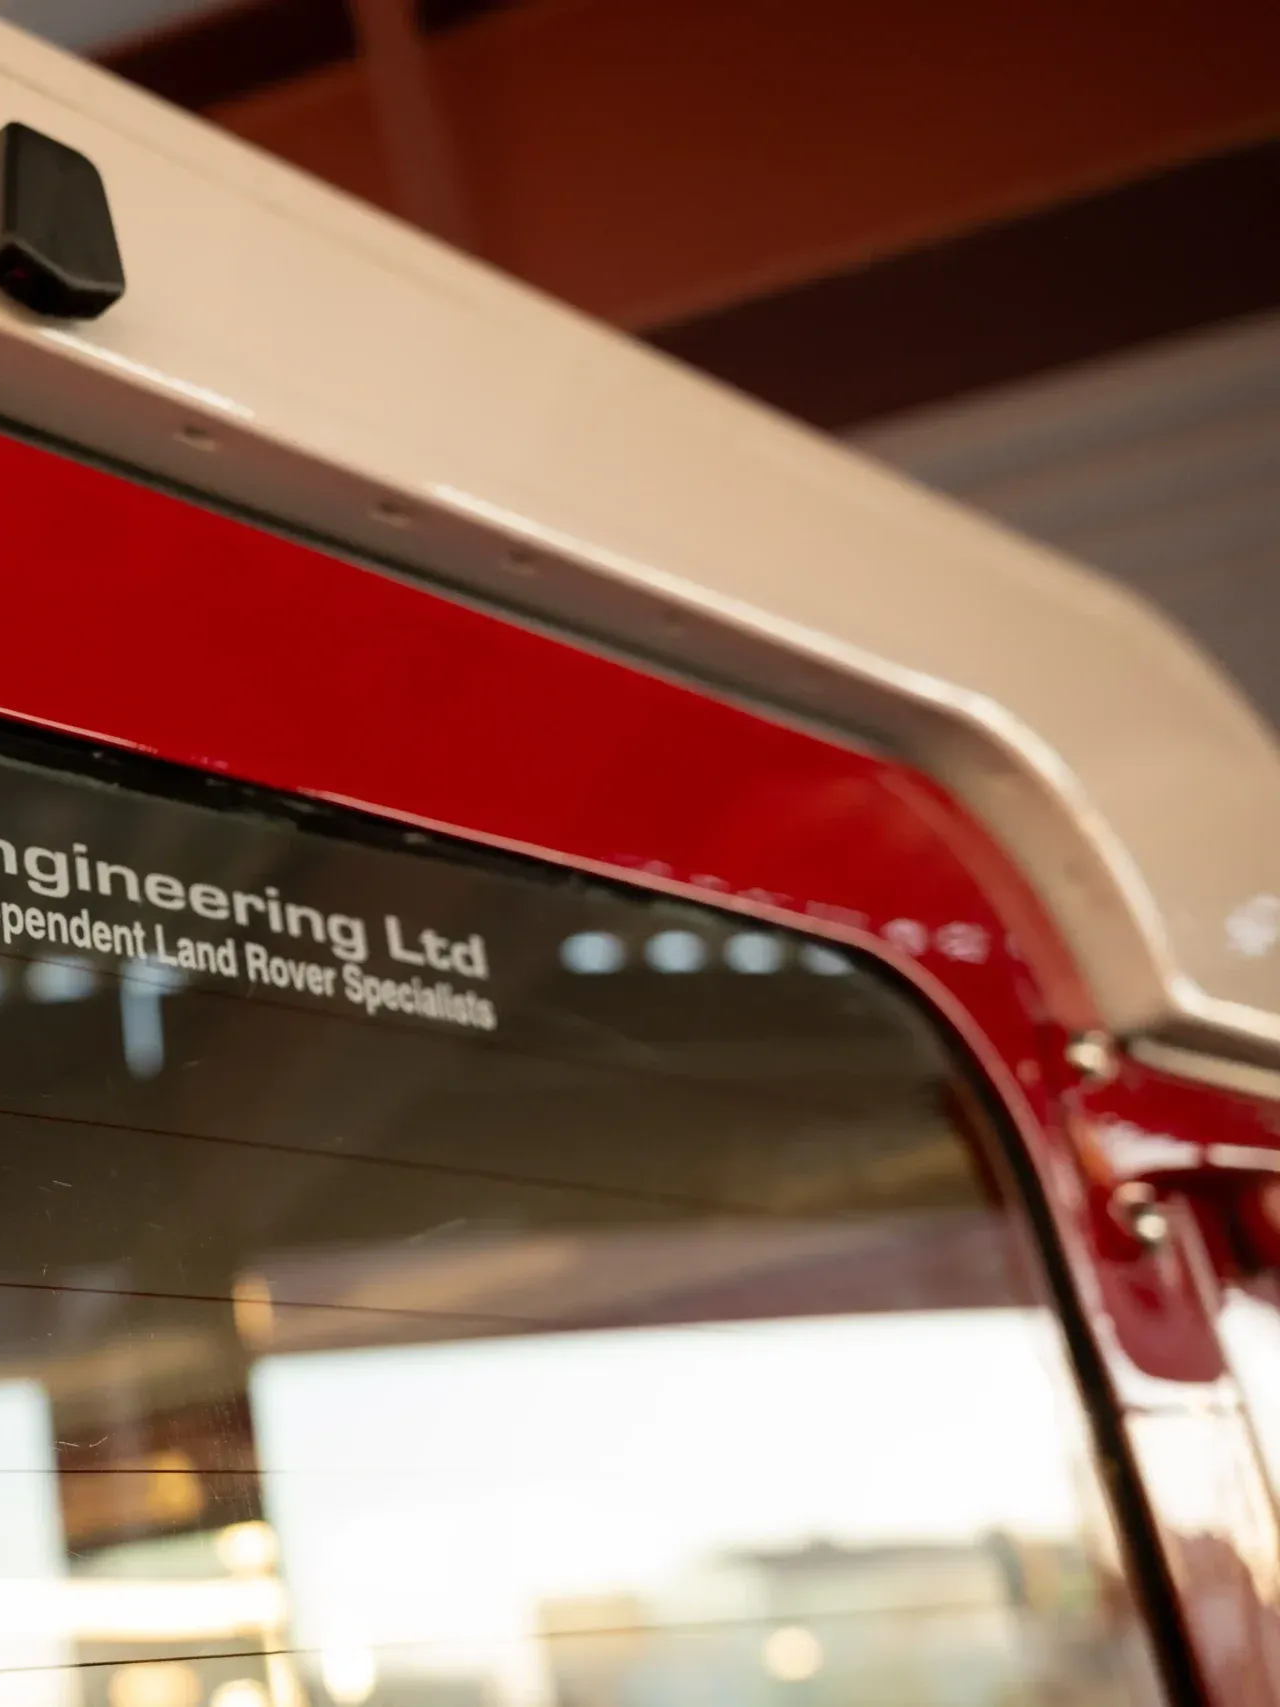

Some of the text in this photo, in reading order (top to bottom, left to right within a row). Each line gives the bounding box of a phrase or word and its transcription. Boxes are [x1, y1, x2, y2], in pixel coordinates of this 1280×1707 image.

[154, 923, 239, 978] Land
[245, 943, 337, 997] Rover
[342, 963, 498, 1031] Specialists
[384, 914, 489, 979] Ltd
